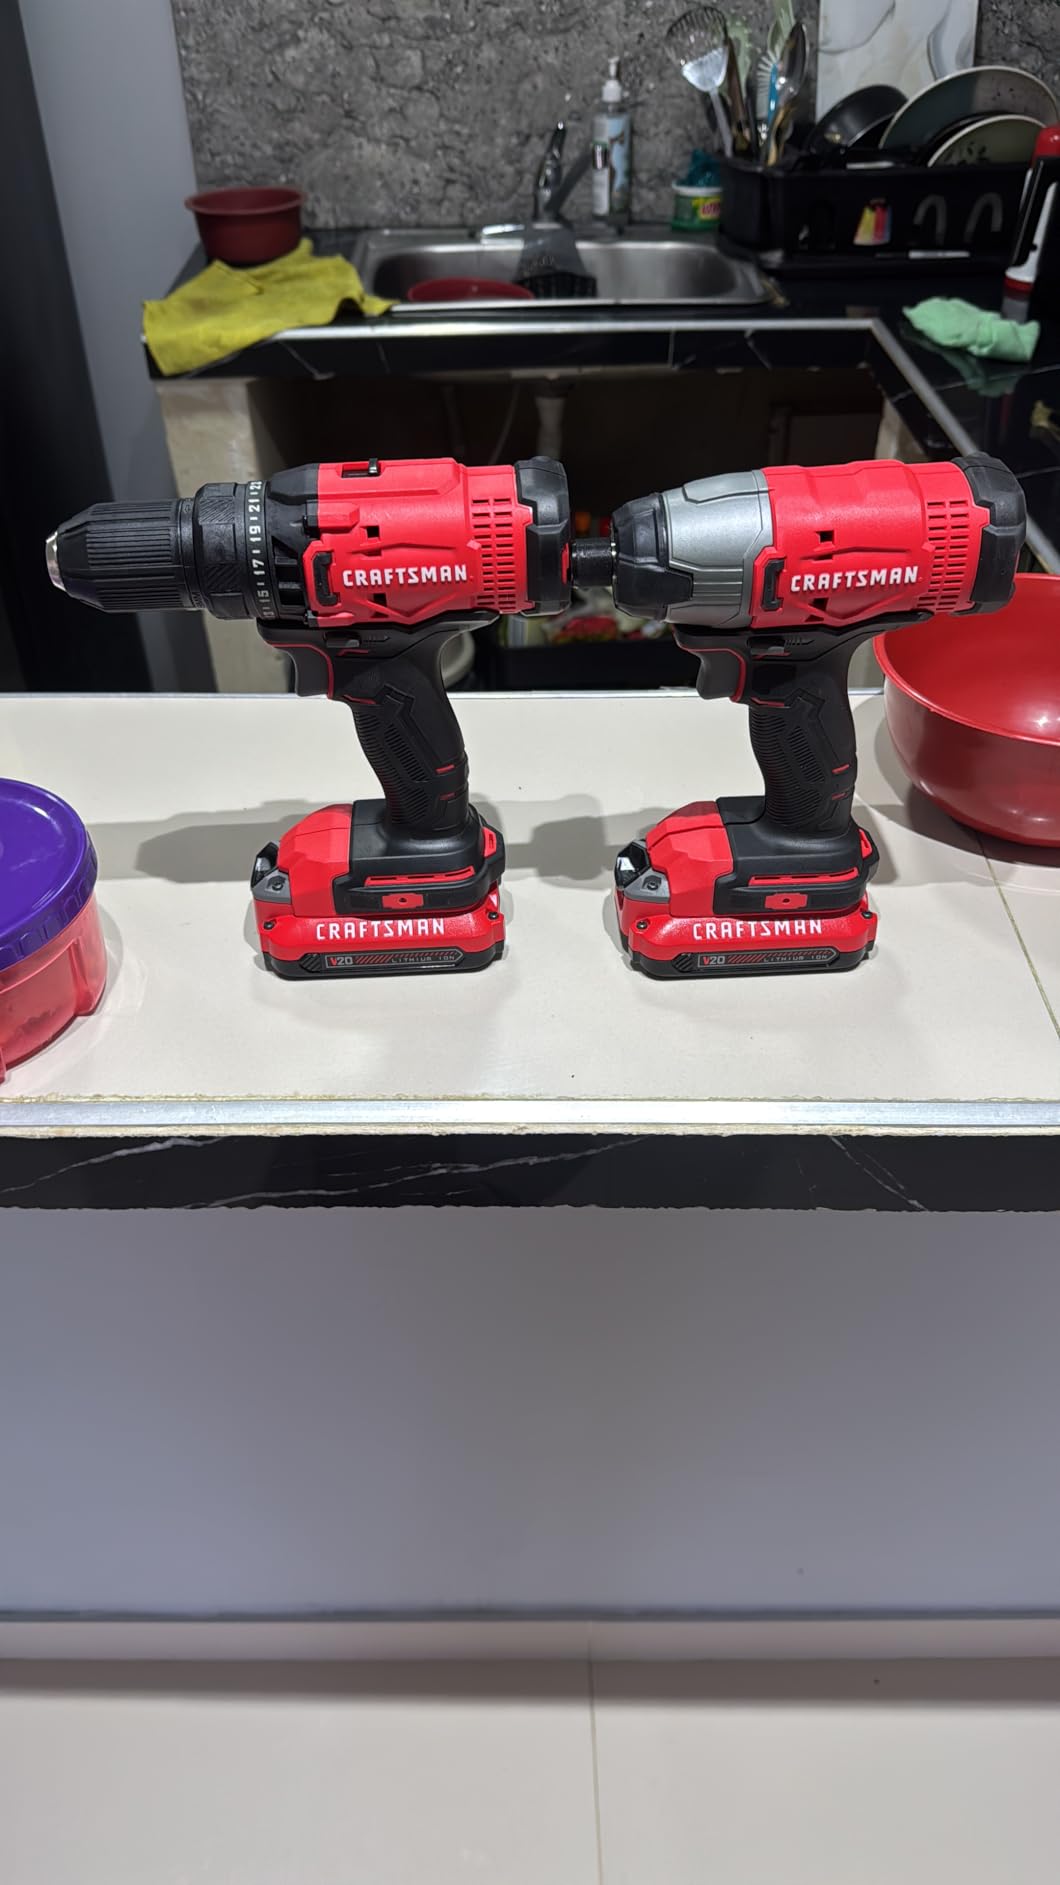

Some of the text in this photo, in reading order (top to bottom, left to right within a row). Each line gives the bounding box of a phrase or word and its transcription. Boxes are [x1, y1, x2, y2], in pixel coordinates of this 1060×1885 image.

[248, 498, 260, 513] 21
[249, 525, 261, 542] 19
[252, 558, 265, 575] 17
[342, 564, 467, 587] CRAFTSMAN
[790, 565, 918, 592] CRAFTSMAN
[316, 918, 445, 941] CRAFTSMAN
[692, 918, 822, 941] CRAFTSMAN
[329, 956, 354, 966] V20
[702, 955, 726, 966] V20
